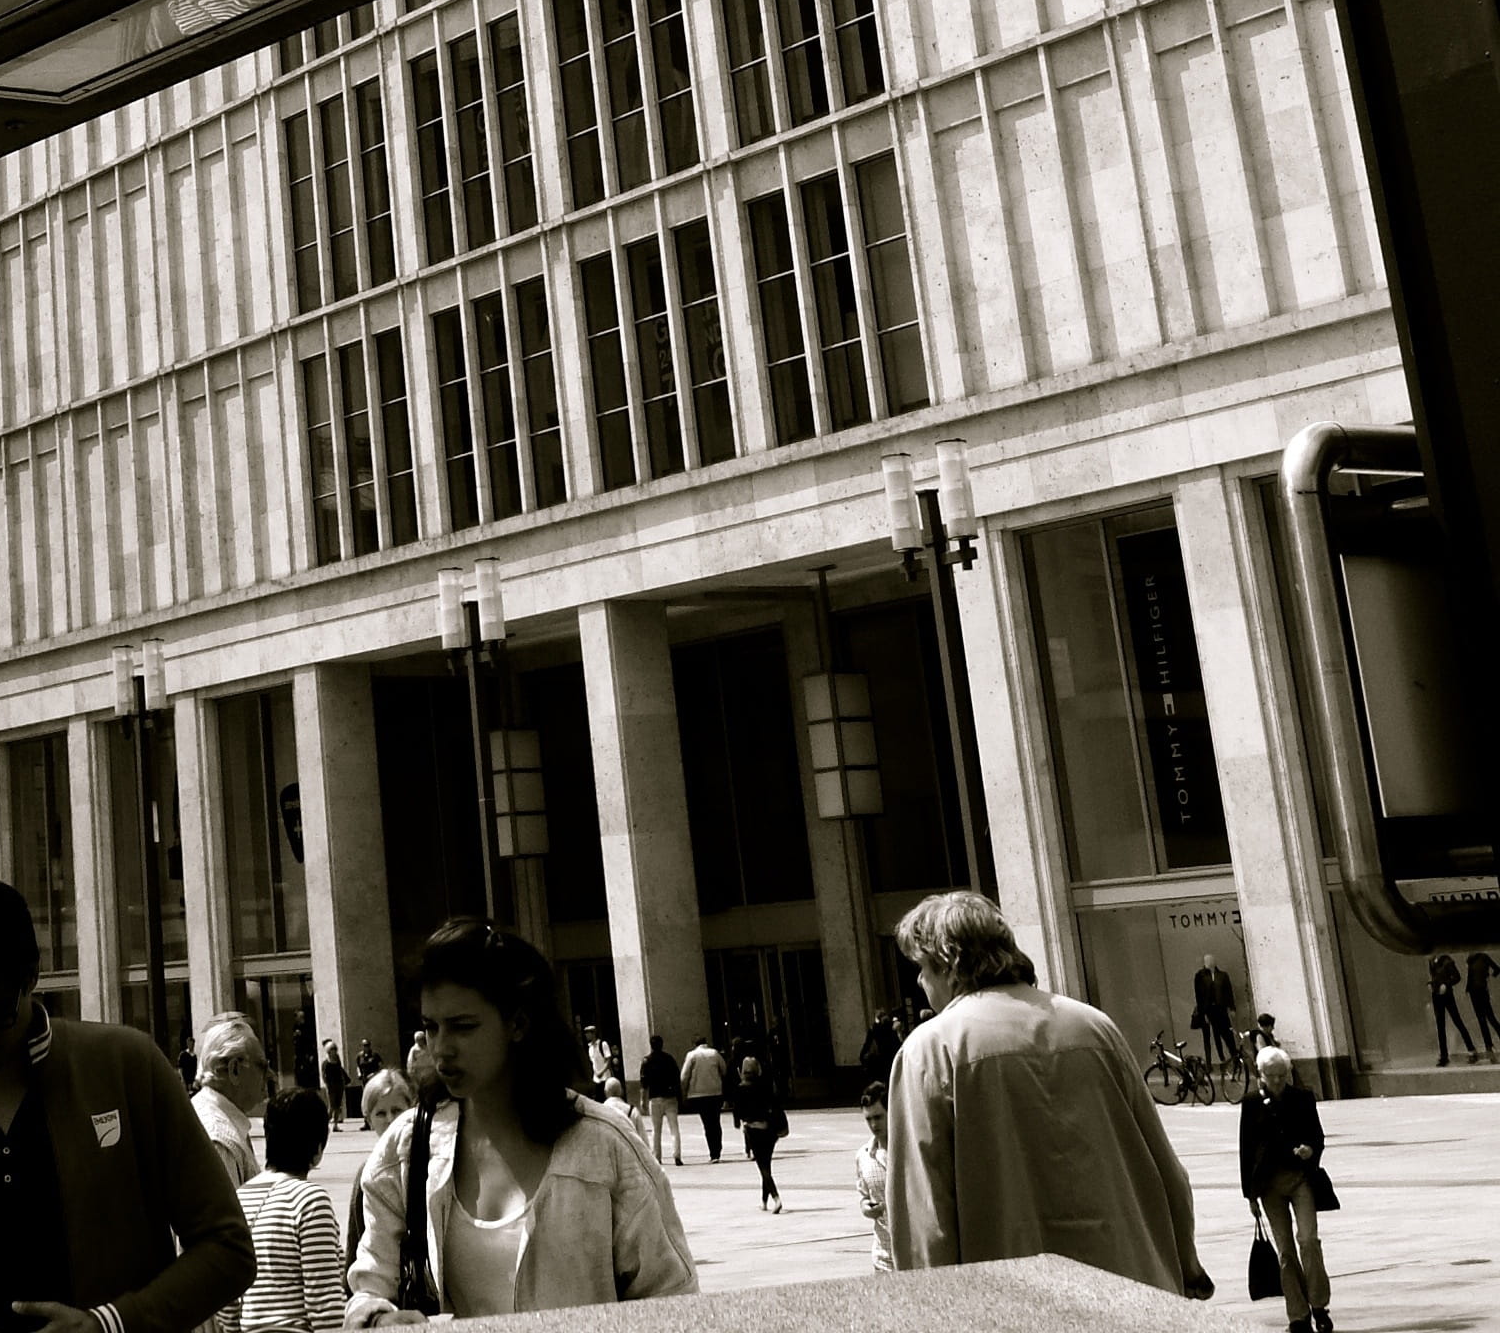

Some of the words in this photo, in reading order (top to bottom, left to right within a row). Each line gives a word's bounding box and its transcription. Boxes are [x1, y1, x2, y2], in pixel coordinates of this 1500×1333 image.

[1144, 575, 1171, 684] HILFIGER
[1167, 724, 1192, 824] TOMMY
[1169, 911, 1227, 929] TOMMY
